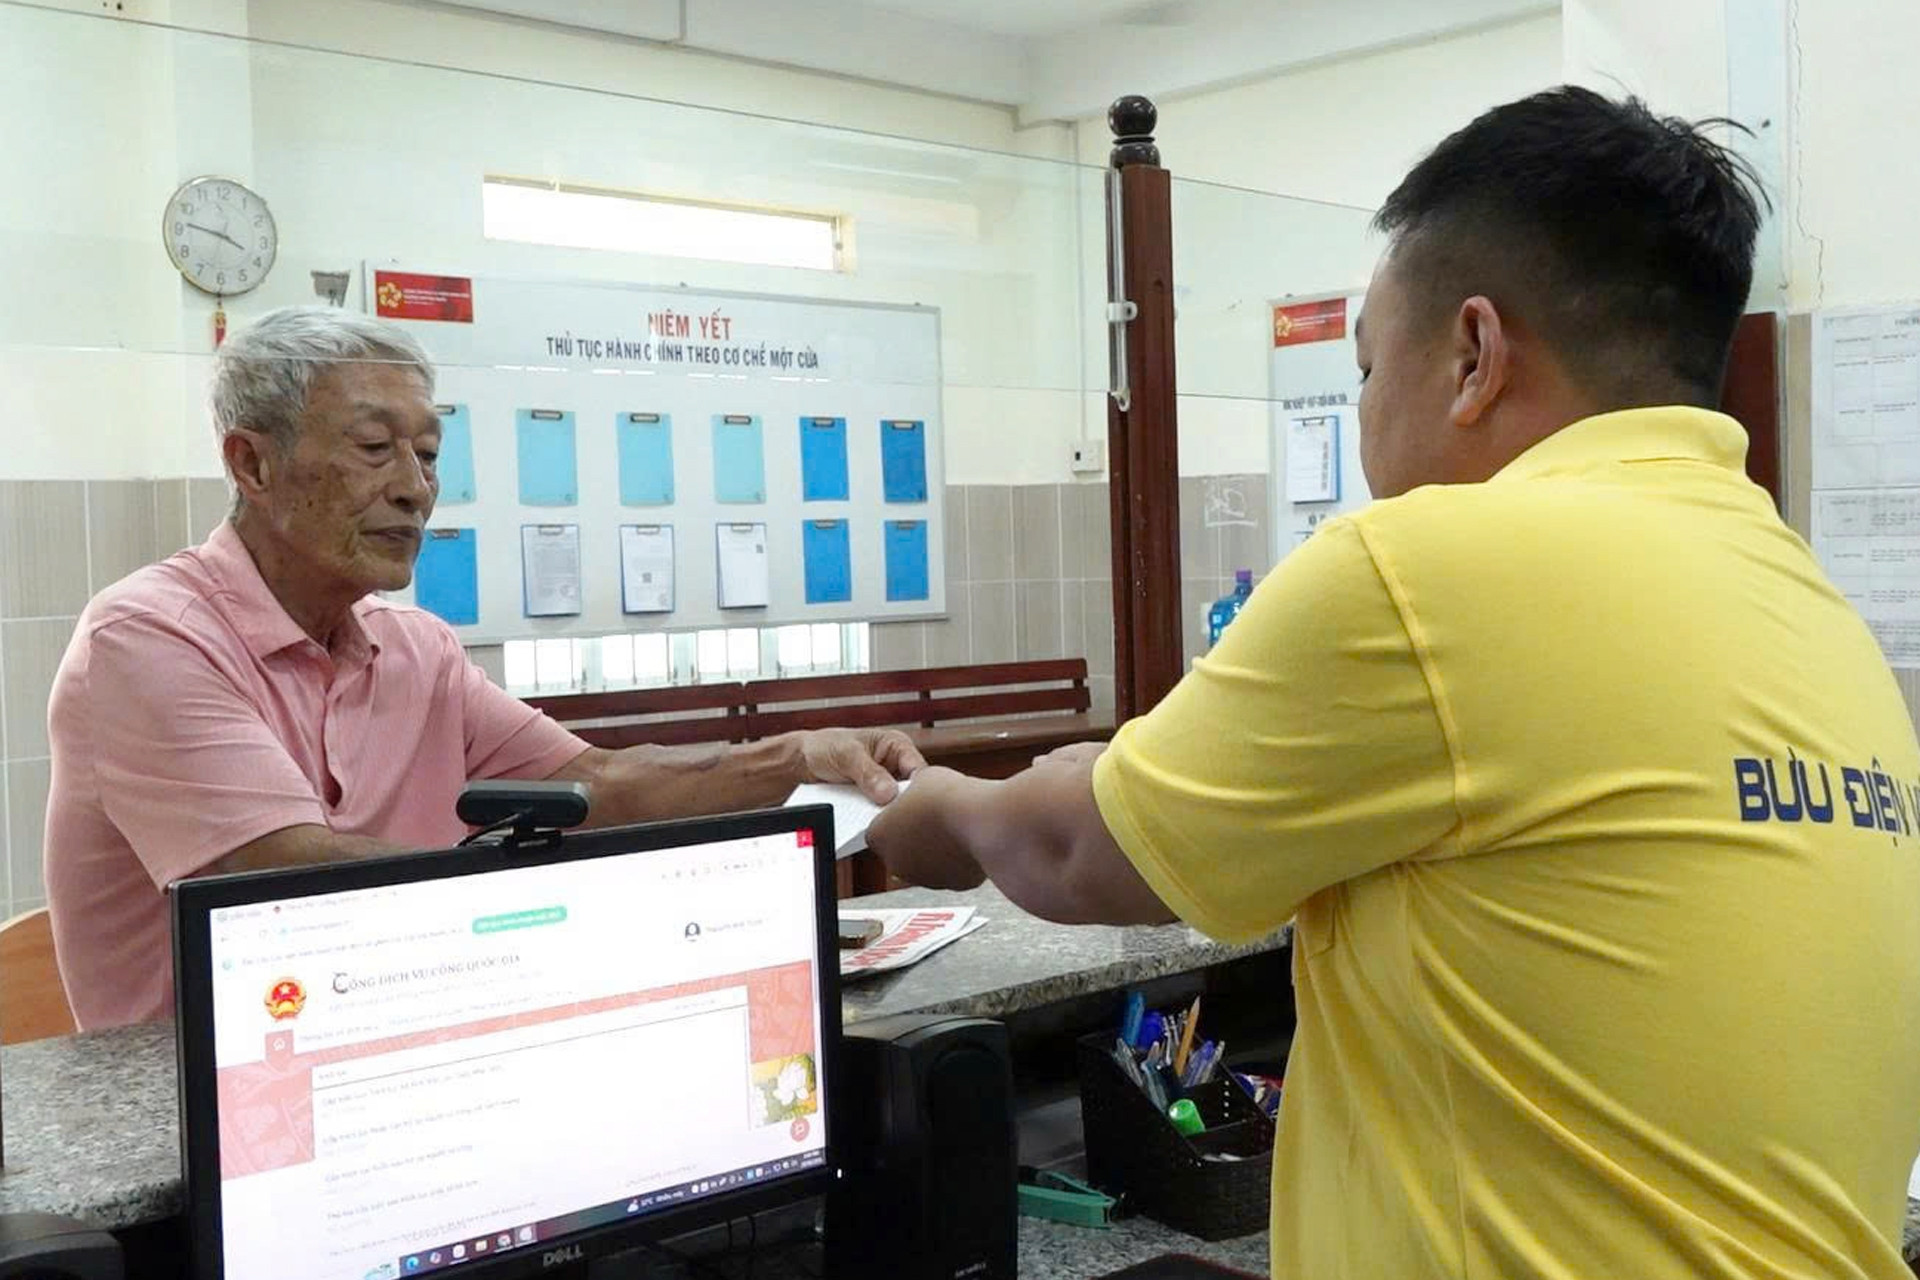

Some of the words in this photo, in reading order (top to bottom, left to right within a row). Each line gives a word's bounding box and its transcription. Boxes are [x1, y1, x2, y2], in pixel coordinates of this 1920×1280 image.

[197, 187, 208, 201] 11
[217, 186, 231, 201] 12
[242, 197, 247, 211] 1
[254, 214, 264, 229] 2
[175, 222, 184, 237] 9
[260, 236, 269, 251] 3
[180, 244, 190, 259] 8
[196, 262, 205, 277] 7
[253, 257, 262, 272] 4
[216, 271, 226, 286] 6
[239, 269, 248, 283] 5
[699, 306, 731, 340] YẾT
[546, 330, 572, 357] THỦ
[577, 338, 602, 361] TỤC
[606, 337, 641, 361] HÀNH
[687, 345, 720, 364] THEO
[743, 340, 766, 367] CHẾ
[770, 345, 794, 371] MỘT
[797, 344, 818, 369] CỬA
[1734, 746, 1833, 824] BƯU
[1840, 756, 1910, 847] ĐIỆN
[542, 1243, 583, 1267] DELL
